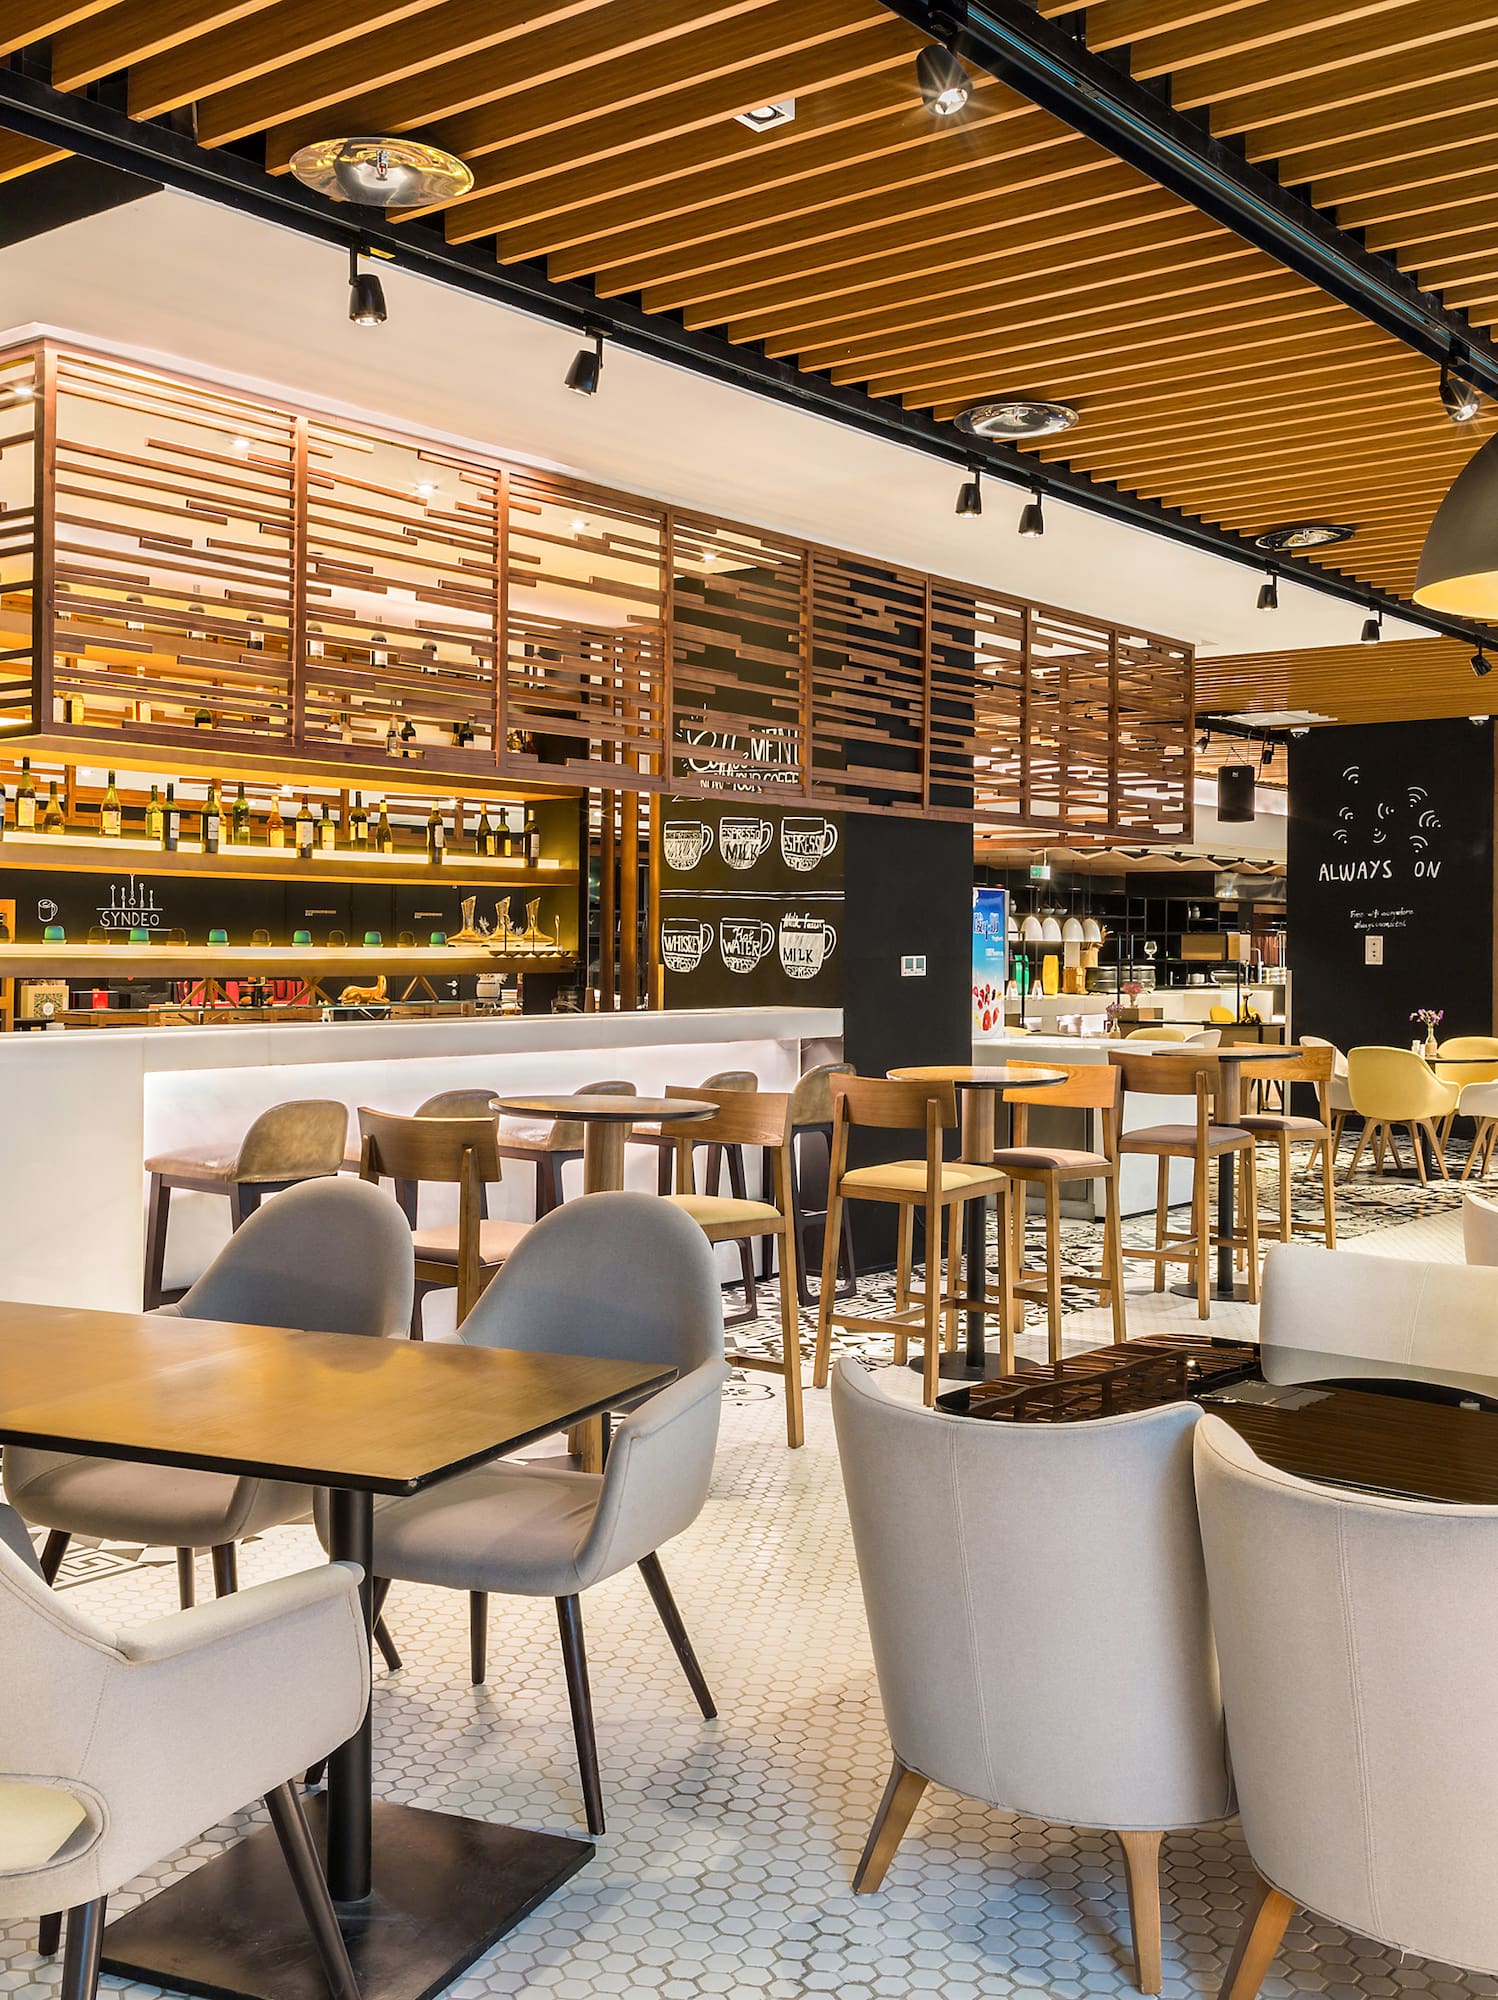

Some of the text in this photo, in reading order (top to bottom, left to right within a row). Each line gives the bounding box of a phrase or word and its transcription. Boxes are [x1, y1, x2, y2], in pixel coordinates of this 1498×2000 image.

[725, 841, 759, 861] MILK
[1318, 860, 1442, 882] ALWAYS ON
[99, 911, 160, 927] SYNDEO
[723, 939, 761, 957] WATER
[783, 947, 814, 963] MILK
